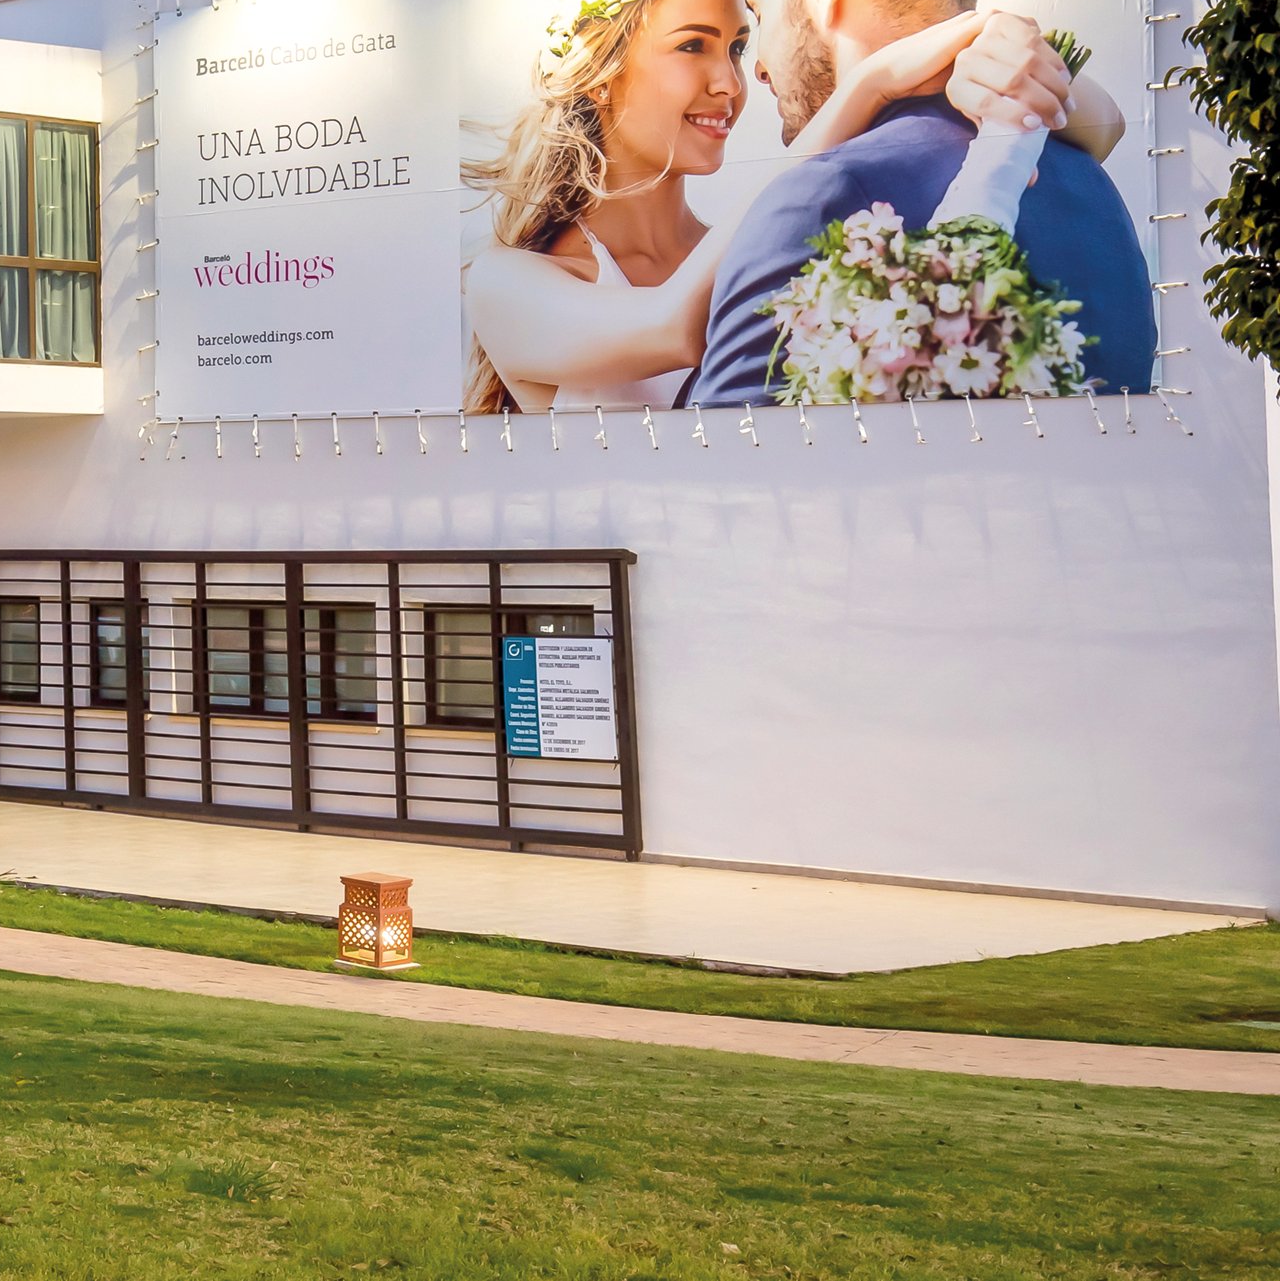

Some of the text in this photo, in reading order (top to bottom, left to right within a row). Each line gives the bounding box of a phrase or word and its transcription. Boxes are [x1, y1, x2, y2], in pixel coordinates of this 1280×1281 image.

[196, 33, 397, 76] Barceló Cabo de Gata
[198, 116, 367, 161] UNA BODA
[198, 156, 411, 206] INOLVIDABLE
[193, 250, 335, 289] weddings
[204, 254, 231, 263] Barceló
[197, 328, 334, 347] barceloweddings.com
[197, 352, 272, 367] barcelo.com
